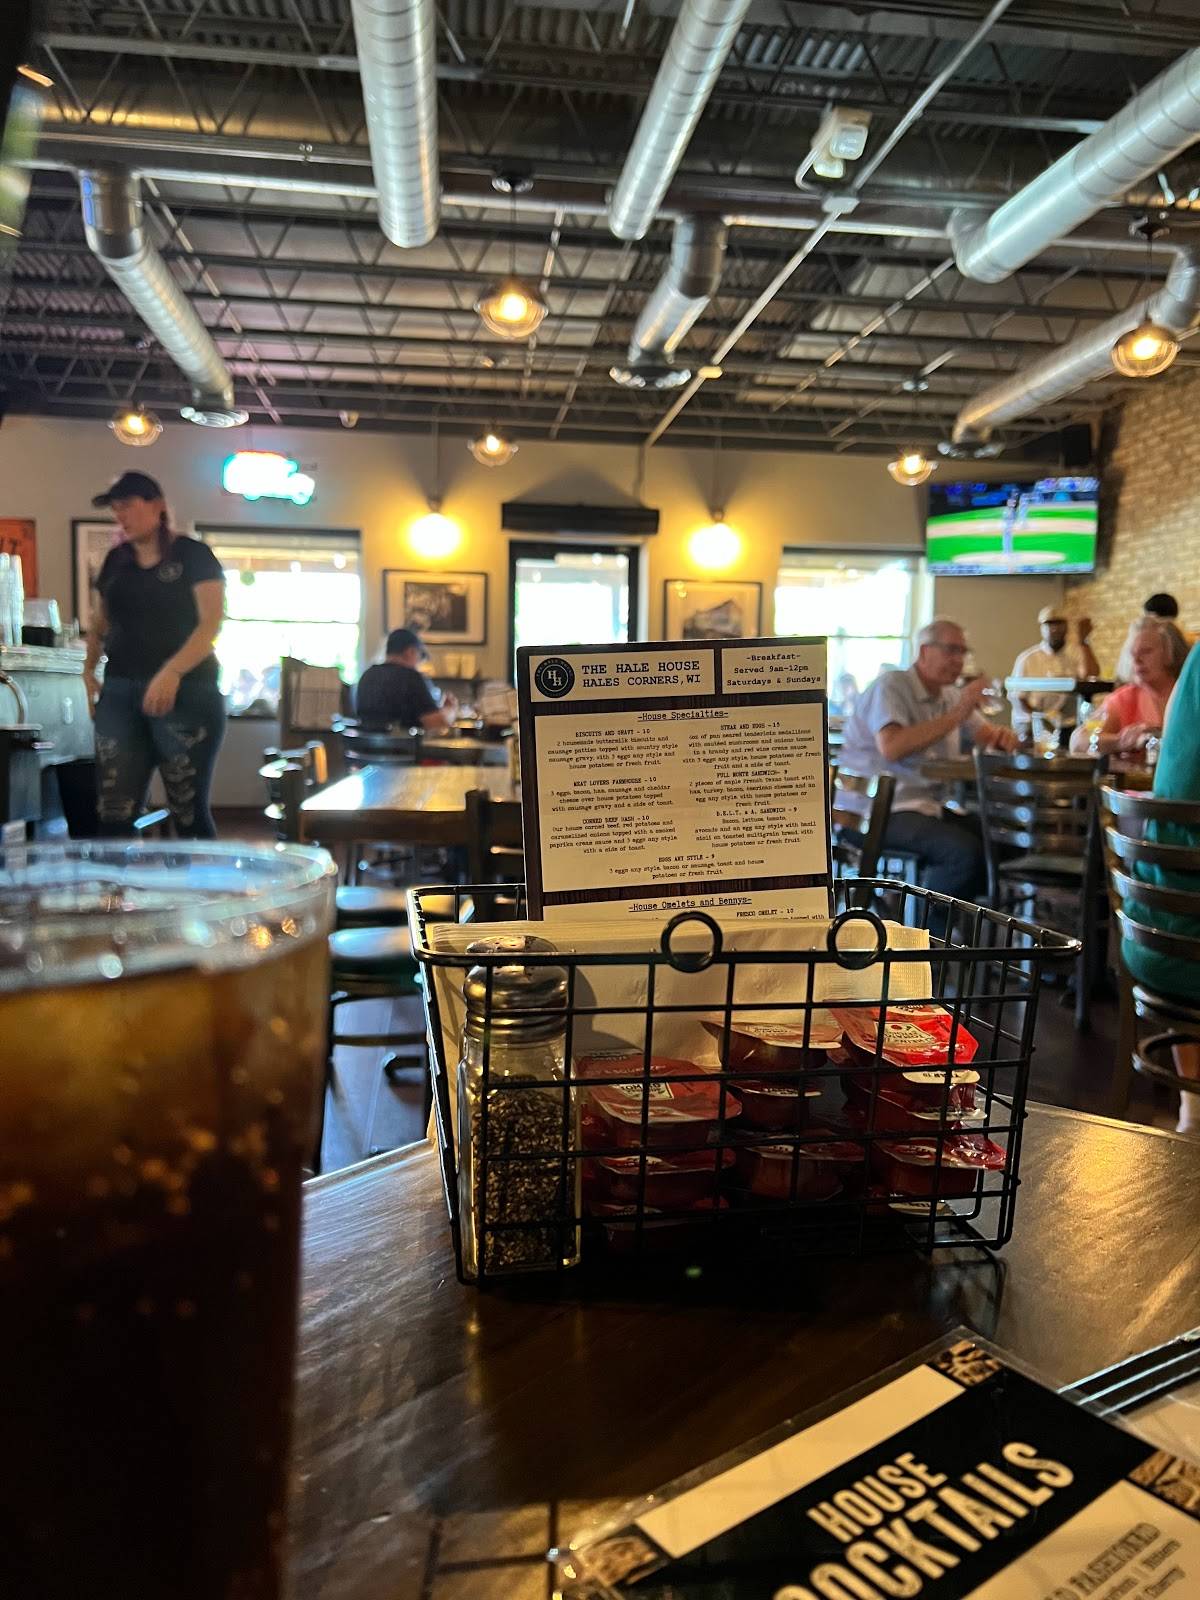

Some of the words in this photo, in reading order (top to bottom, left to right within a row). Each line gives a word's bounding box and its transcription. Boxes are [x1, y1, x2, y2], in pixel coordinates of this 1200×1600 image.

[582, 664, 607, 675] THE
[616, 663, 649, 673] HALE
[658, 661, 700, 672] HOUSE
[583, 678, 620, 687] HALES
[727, 678, 771, 686] Saturdays
[662, 900, 695, 908] Omelets
[806, 1452, 948, 1543] HOUSE
[773, 1442, 1074, 1600] OCKTAILS
